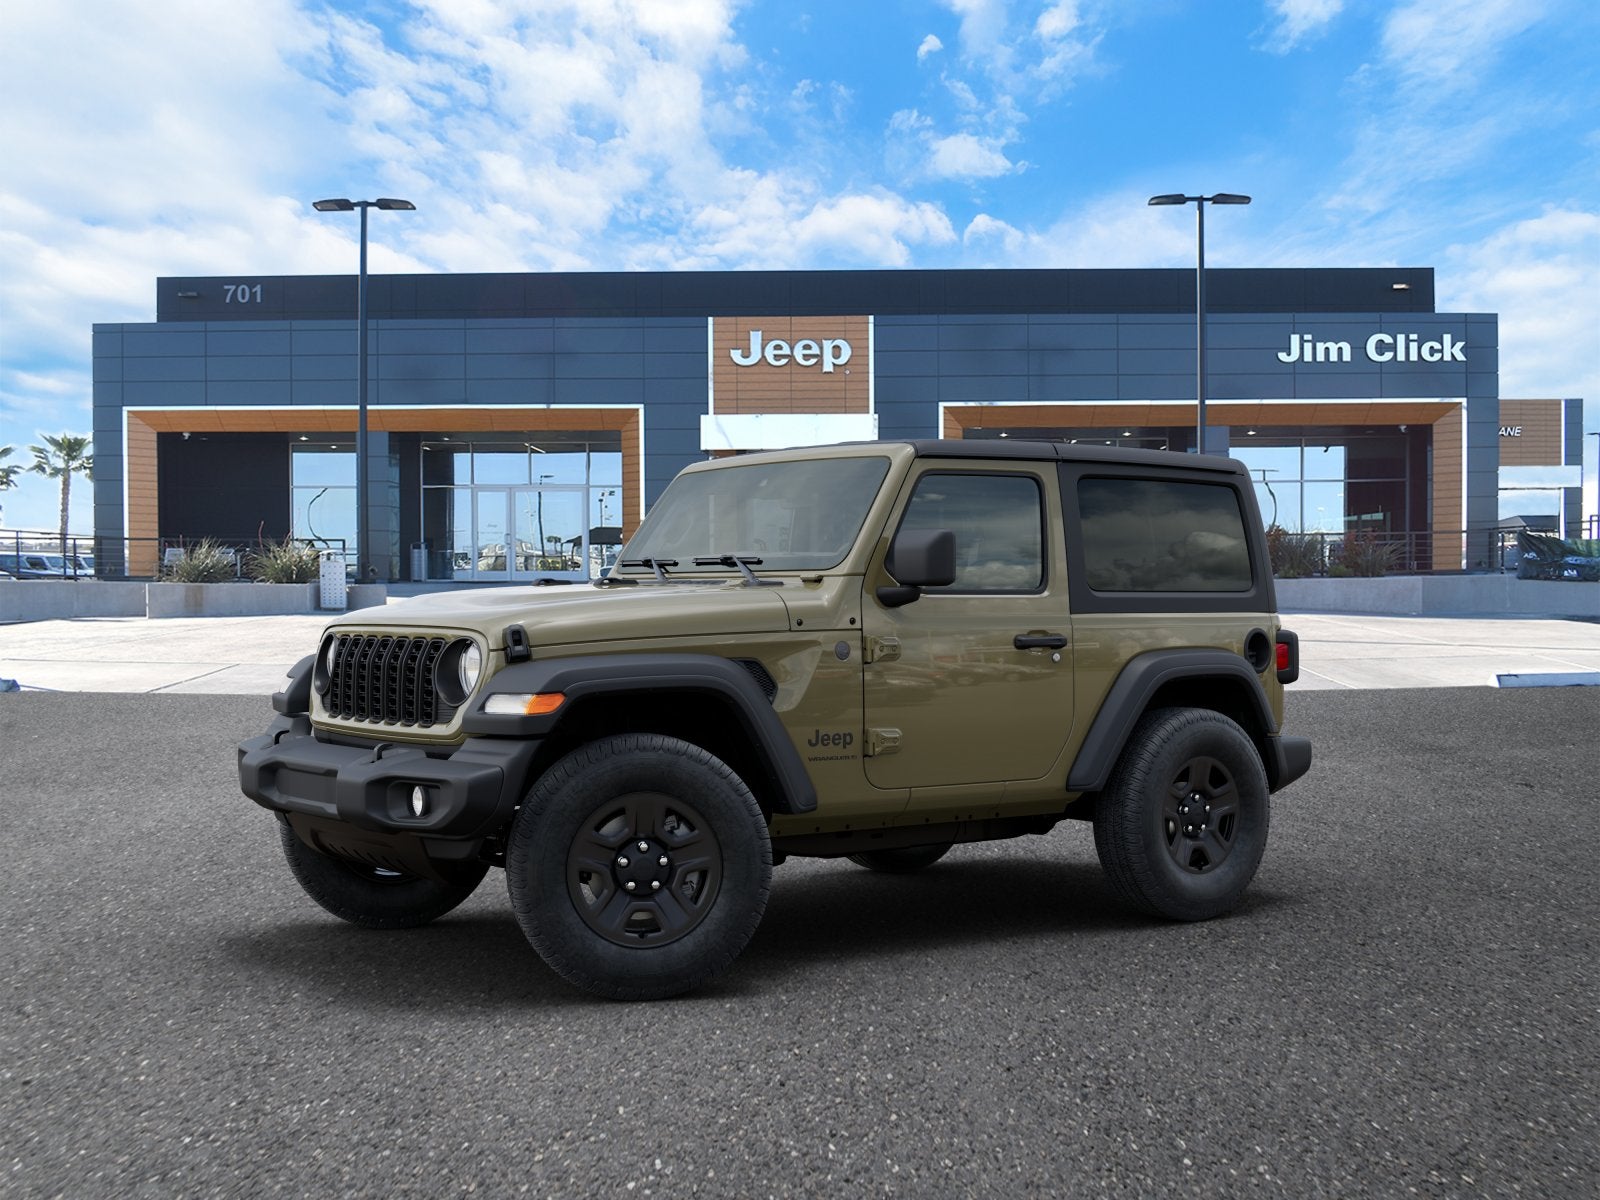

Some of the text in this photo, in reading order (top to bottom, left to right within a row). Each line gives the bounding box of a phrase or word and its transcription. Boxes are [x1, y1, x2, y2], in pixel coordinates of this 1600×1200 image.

[223, 284, 262, 303] 701
[730, 330, 852, 373] Jeep
[1277, 333, 1467, 363] Jim Click
[1498, 426, 1522, 437] ANE
[807, 729, 854, 749] Jeep
